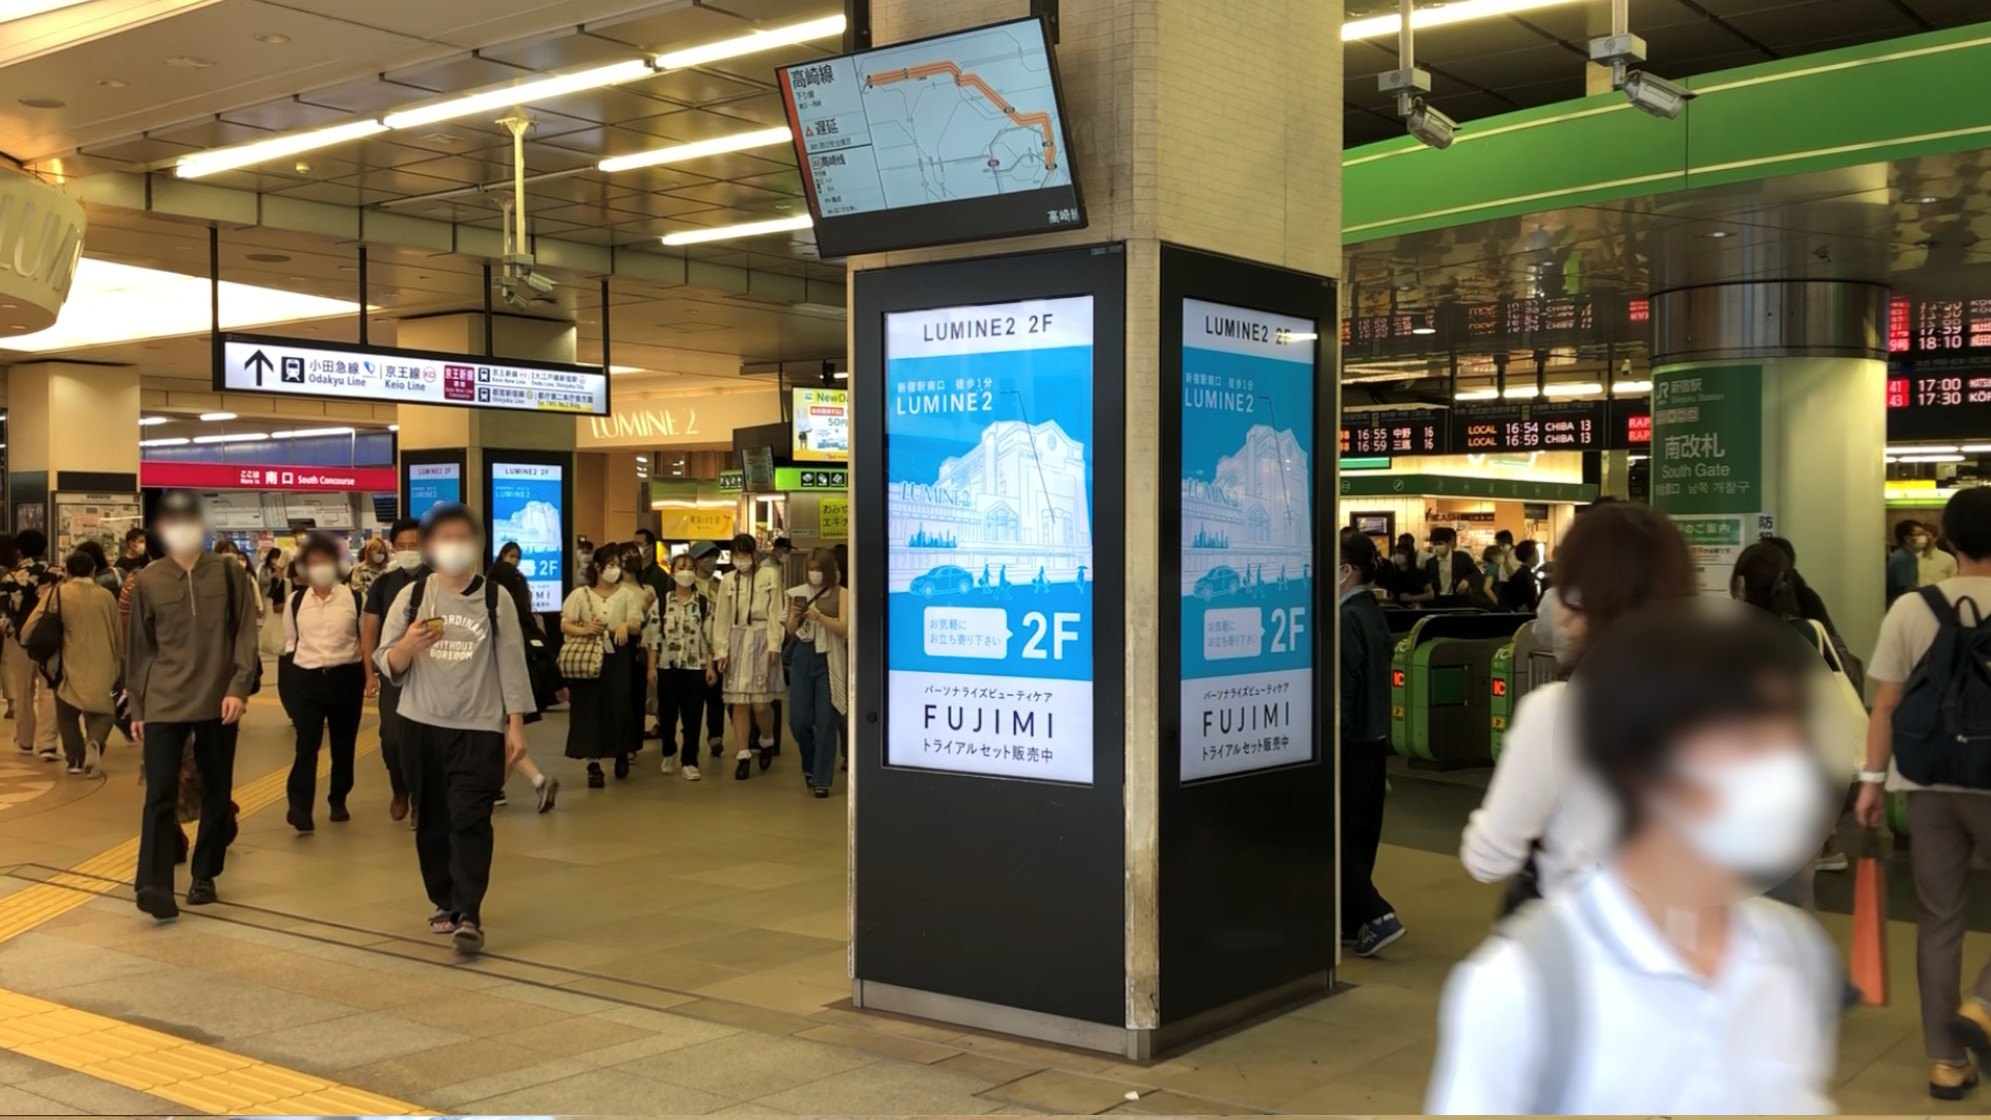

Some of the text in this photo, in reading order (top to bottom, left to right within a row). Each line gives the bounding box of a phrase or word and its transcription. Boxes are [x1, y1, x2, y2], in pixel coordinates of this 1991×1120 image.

[791, 64, 834, 89] 高崎線
[923, 314, 1053, 342] LUMINE2 2F
[1205, 315, 1269, 343] LUMINE2
[1918, 335, 1962, 350] 18:10
[309, 360, 360, 375] 小田急線
[385, 365, 421, 380] 京王線
[308, 374, 366, 387] Odakyu Line
[385, 380, 426, 391] Keio Line
[897, 377, 993, 393] 新宿駅南口 徒歩1分
[1186, 372, 1222, 386] 新宿駅南口
[1671, 378, 1702, 393] 新宿駅
[1918, 378, 1962, 392] 17:00
[817, 392, 848, 403] NewD
[1656, 381, 1669, 399] JR
[896, 392, 993, 415] LUMINE2
[1185, 387, 1254, 413] LUMINE2
[1889, 395, 1903, 407] 43
[1918, 392, 1962, 406] 17:30
[590, 408, 700, 439] LUMINE 2
[1467, 420, 1591, 435] LOCAL 16:54 CHIBA 13
[1357, 428, 1387, 440] 16:55
[1392, 427, 1411, 438] 中野
[1424, 426, 1434, 438] 16
[1467, 432, 1591, 447] LOCAL 16:59 CHIBA 13
[1357, 440, 1387, 452] 16:59
[1424, 438, 1434, 450] 16
[1665, 433, 1726, 460] 南改札
[265, 471, 294, 485] 南口
[1662, 462, 1731, 479] South Gate
[298, 475, 355, 486] South Concourse
[539, 560, 558, 576] 2F
[930, 619, 967, 631] お気軽に
[1270, 606, 1306, 653] 2F
[930, 633, 1001, 647] お立ち寄り下さい
[1021, 611, 1081, 660] 2F
[924, 685, 1053, 703] パーソナライズビューティケア
[1203, 683, 1290, 700] パーソナライズビューティケア
[924, 704, 1053, 739] FUJIMI
[1202, 701, 1289, 737] FUJIMI
[923, 738, 1053, 763] トライアルセット販売中
[1202, 735, 1289, 762] トライアルセット販売中
